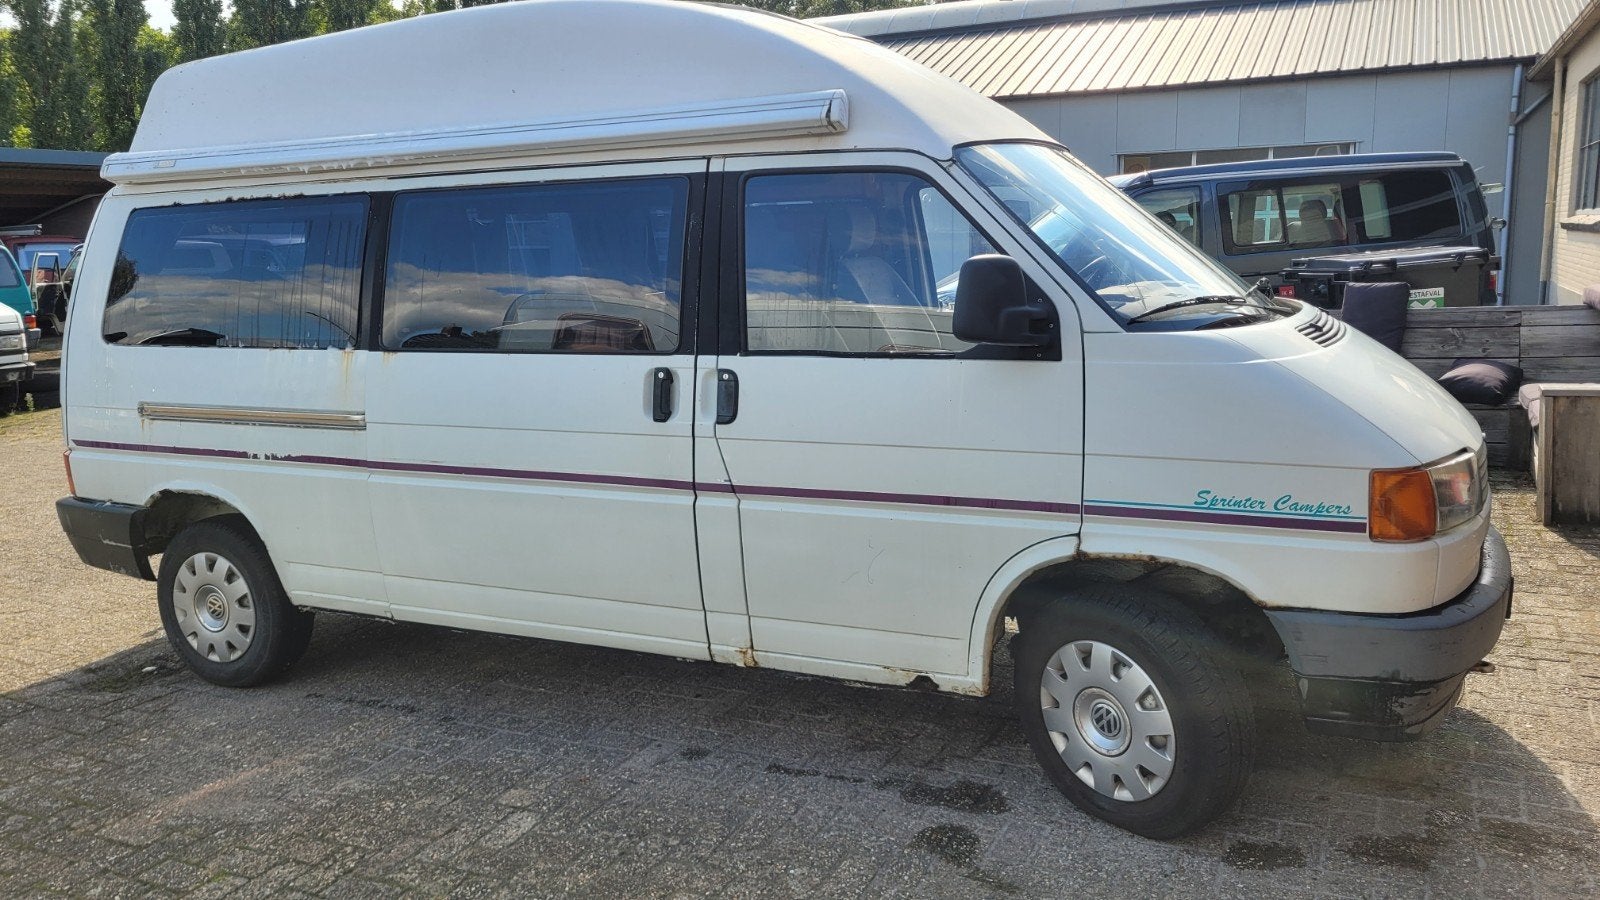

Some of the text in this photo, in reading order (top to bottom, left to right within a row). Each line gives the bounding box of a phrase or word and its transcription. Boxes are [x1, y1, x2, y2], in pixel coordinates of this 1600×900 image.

[1409, 290, 1441, 298] ESTAFVAL
[1194, 489, 1352, 515] Sprinter Campers
